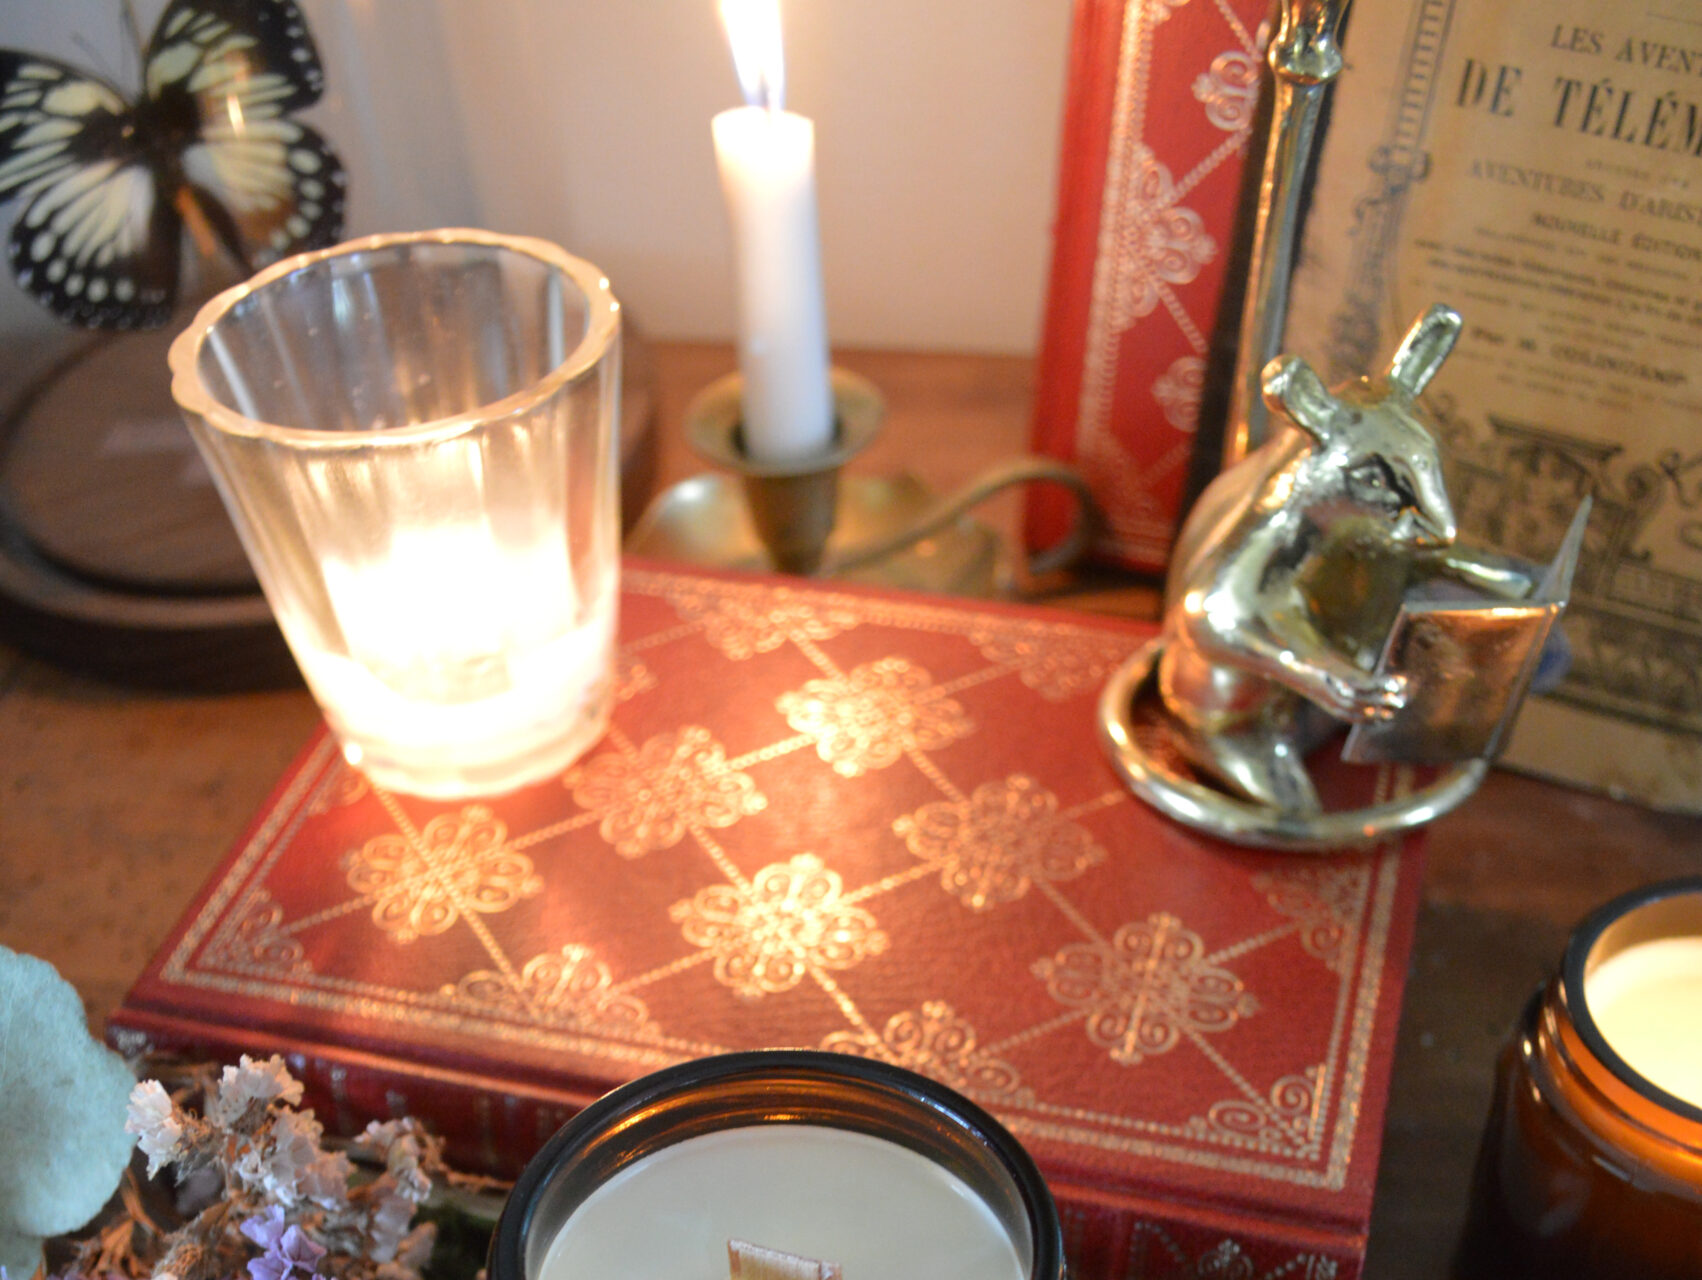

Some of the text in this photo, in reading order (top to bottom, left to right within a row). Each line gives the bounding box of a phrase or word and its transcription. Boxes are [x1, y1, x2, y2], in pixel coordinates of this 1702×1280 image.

[1551, 23, 1702, 77] LES AVEN
[1455, 57, 1523, 118] DE
